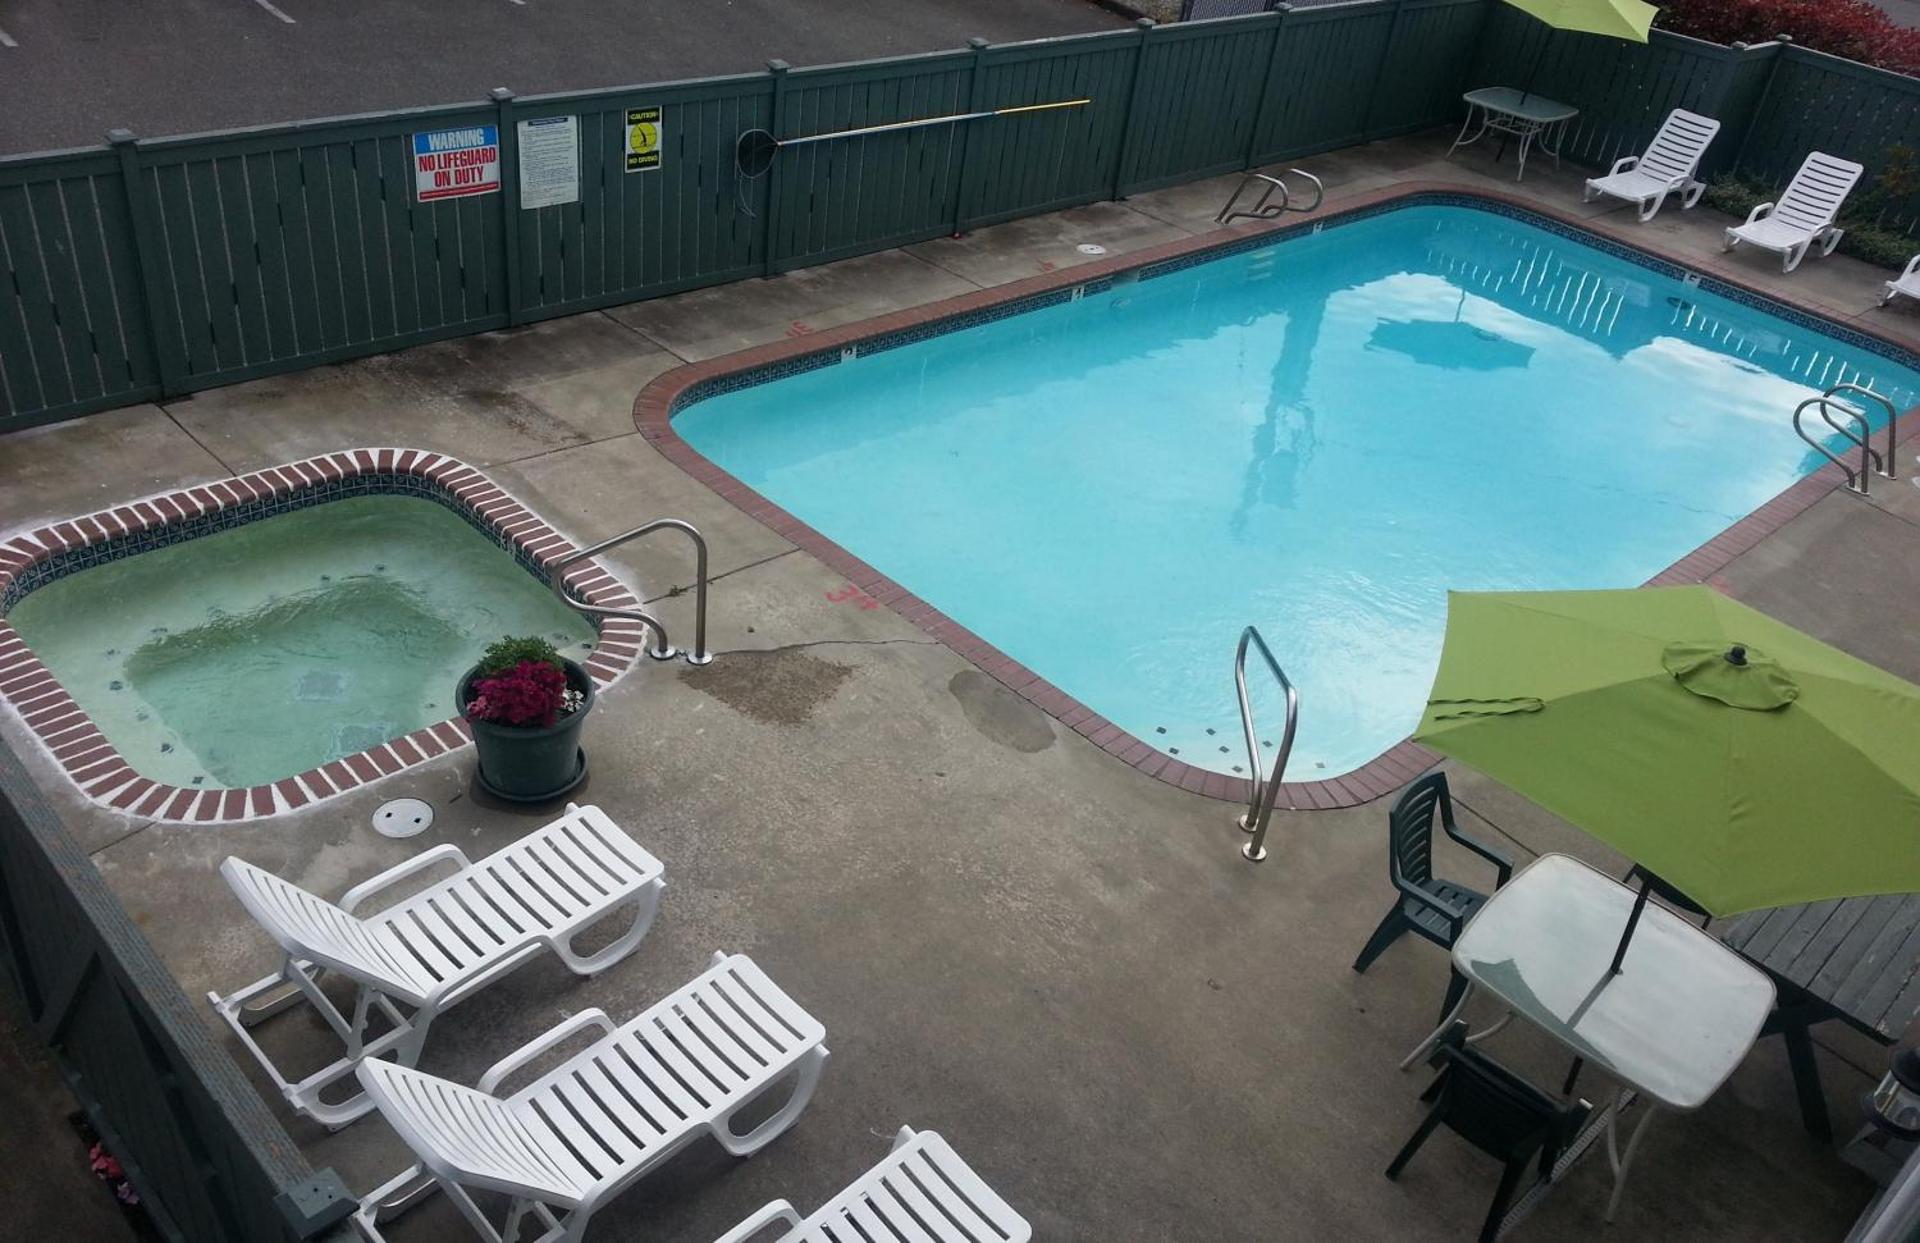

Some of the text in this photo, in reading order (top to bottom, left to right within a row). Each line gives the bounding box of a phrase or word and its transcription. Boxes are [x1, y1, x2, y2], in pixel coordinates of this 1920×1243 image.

[428, 128, 484, 151] WARNING
[419, 147, 496, 172] NO LIFEGUARD
[434, 166, 484, 187] ON DUTY
